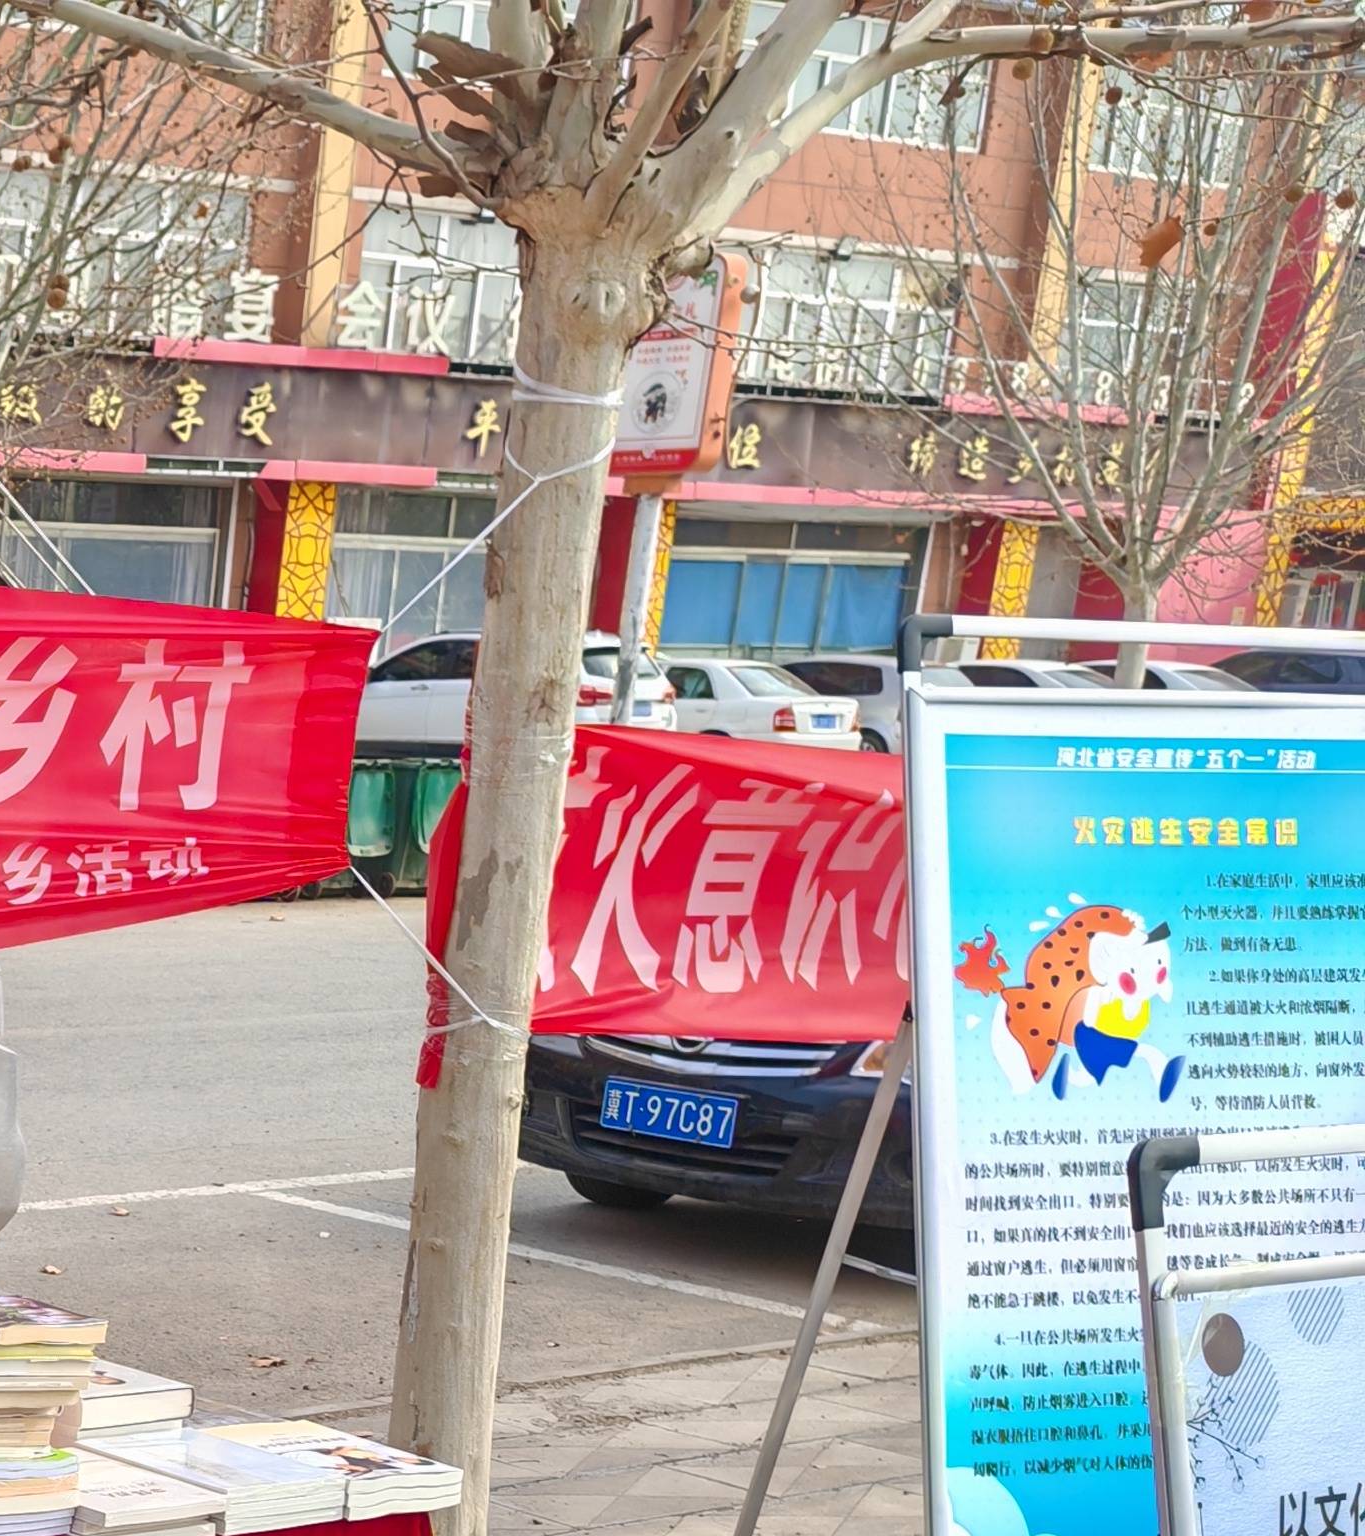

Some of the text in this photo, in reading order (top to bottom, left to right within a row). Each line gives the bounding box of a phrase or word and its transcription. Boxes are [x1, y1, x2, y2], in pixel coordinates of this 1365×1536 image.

[1073, 815, 1300, 847] 火灾逃生安全常识
